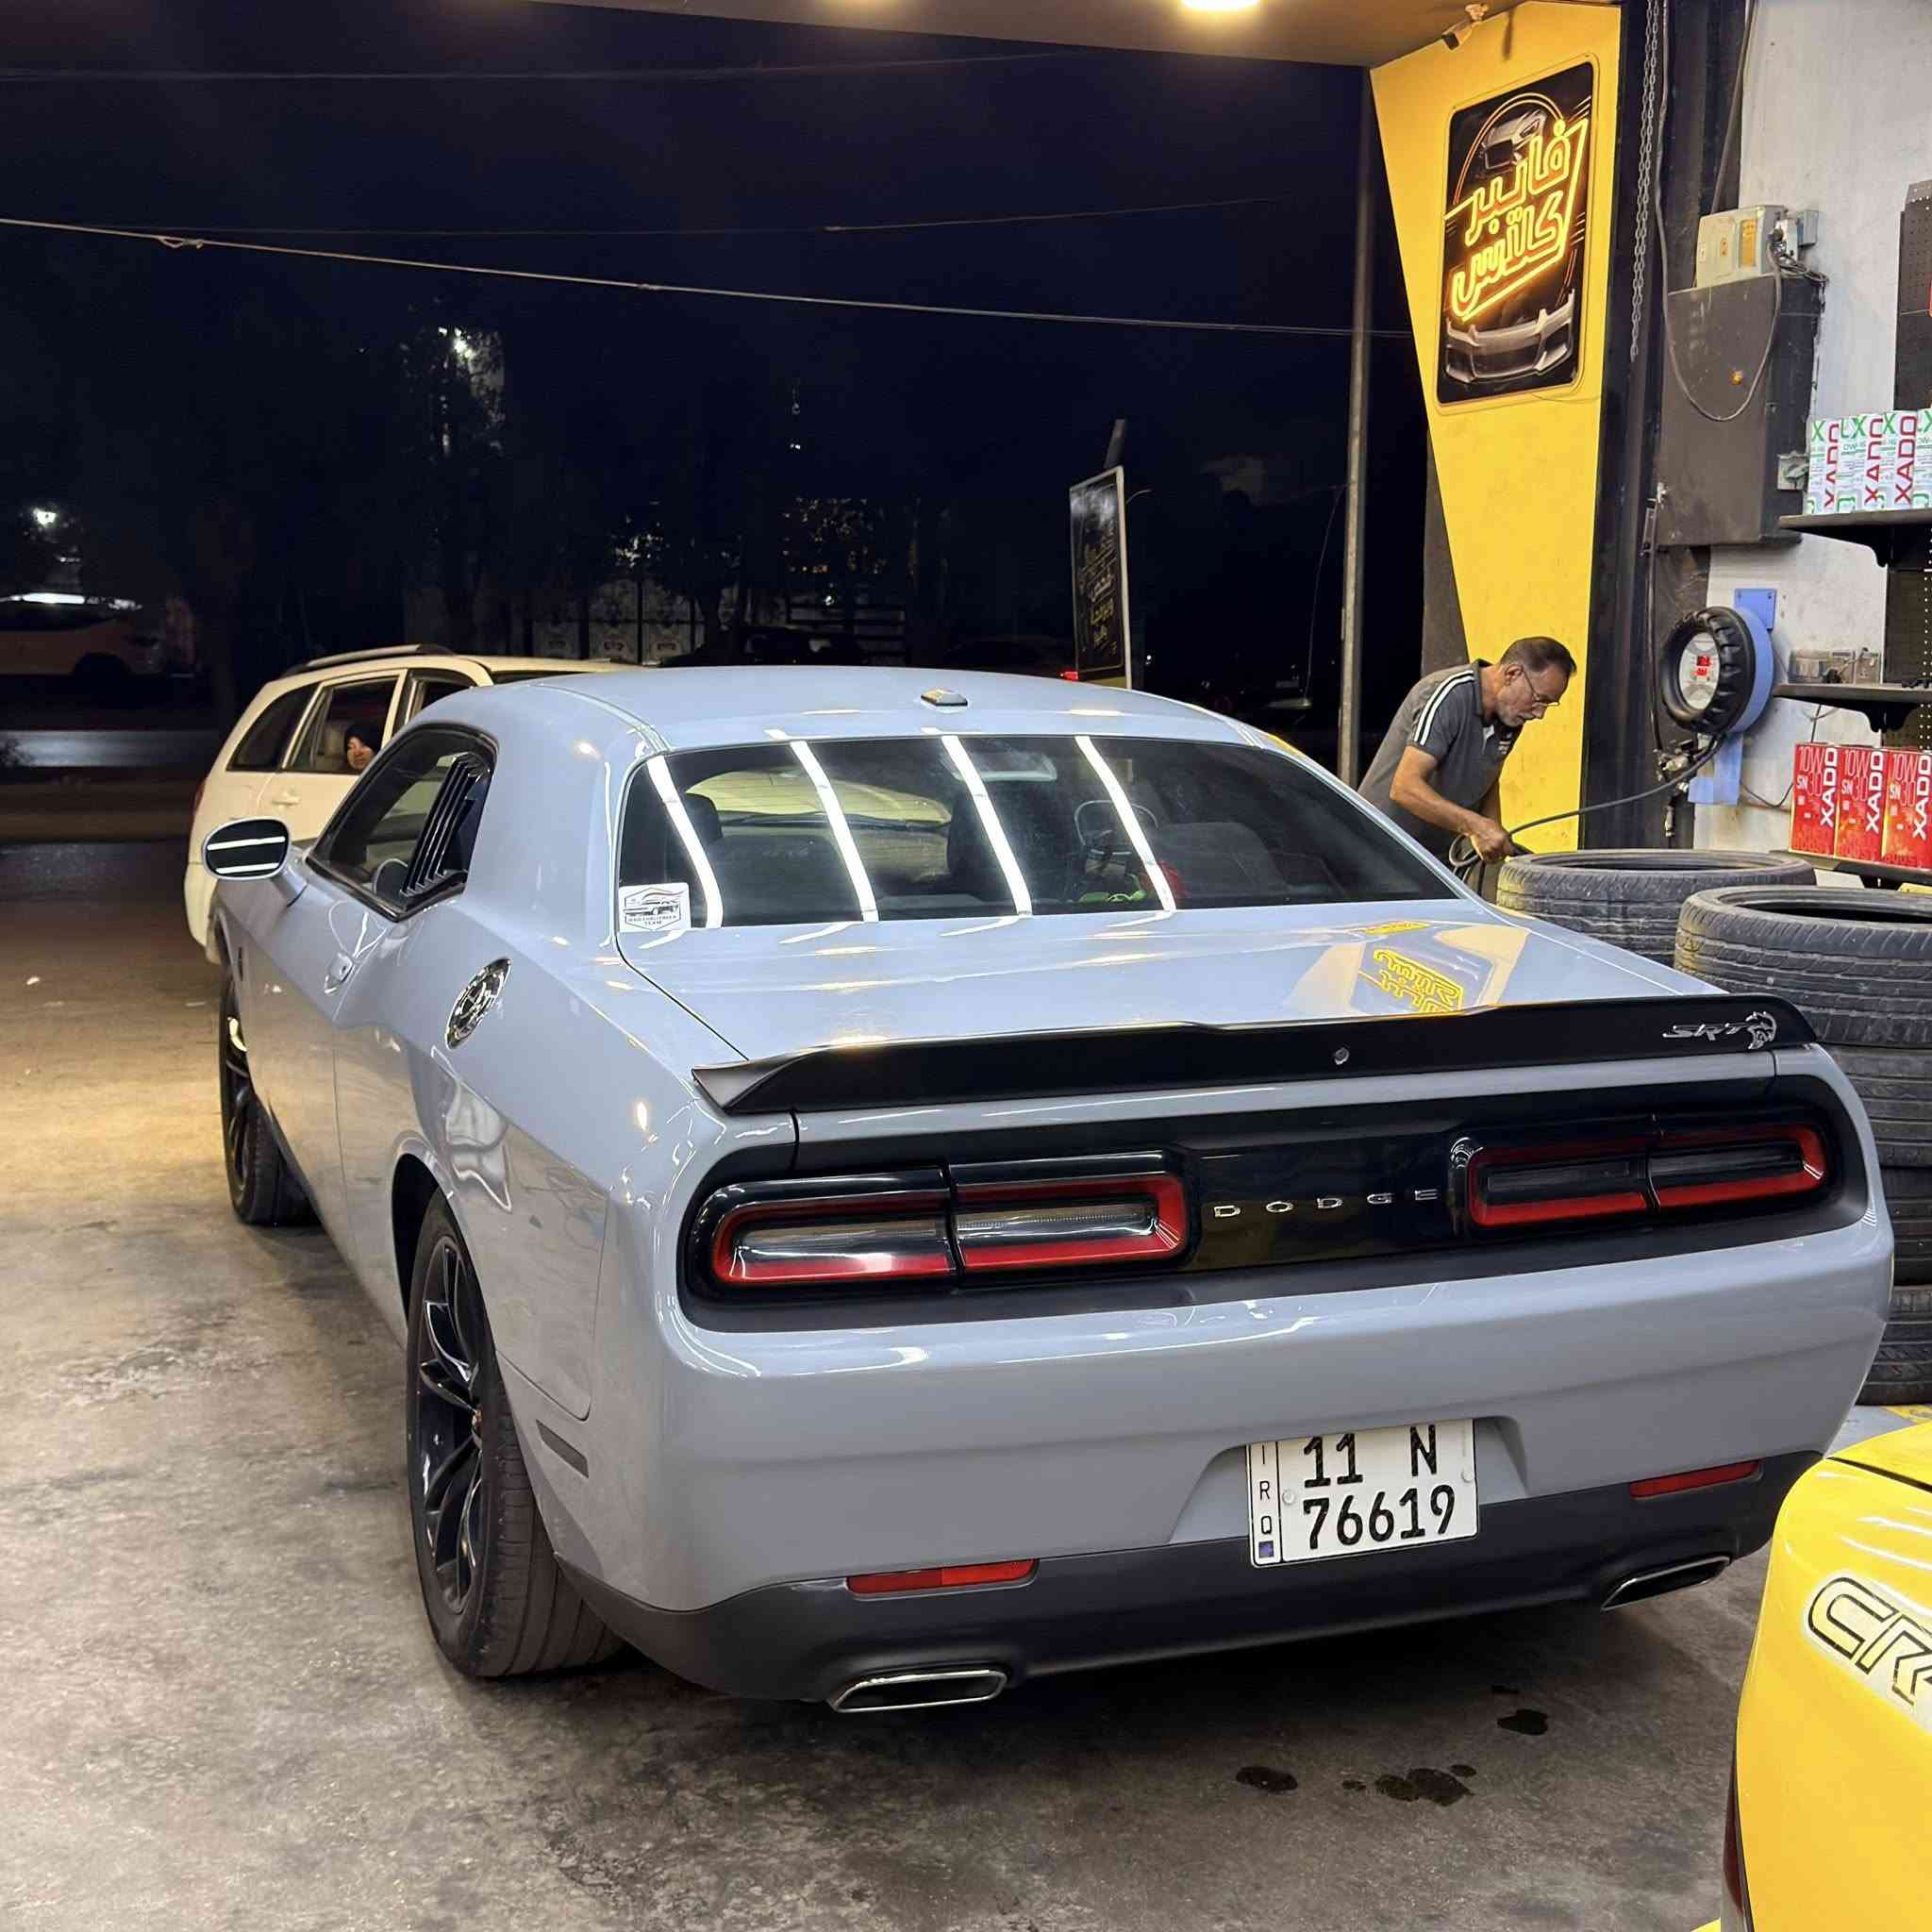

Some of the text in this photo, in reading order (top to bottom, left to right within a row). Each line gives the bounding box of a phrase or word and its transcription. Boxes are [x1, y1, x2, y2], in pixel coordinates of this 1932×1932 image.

[1465, 118, 1572, 246] فايبر
[1864, 417, 1884, 505] XADO
[1894, 415, 1918, 505] XADO
[1820, 747, 1838, 828] XADO
[1866, 751, 1884, 833] XADO
[1912, 755, 1932, 841] XADO
[1662, 1023, 1745, 1041] SRT
[1213, 1189, 1439, 1218] DODGE
[1304, 1424, 1438, 1489] 11 N
[1303, 1484, 1455, 1550] 76619
